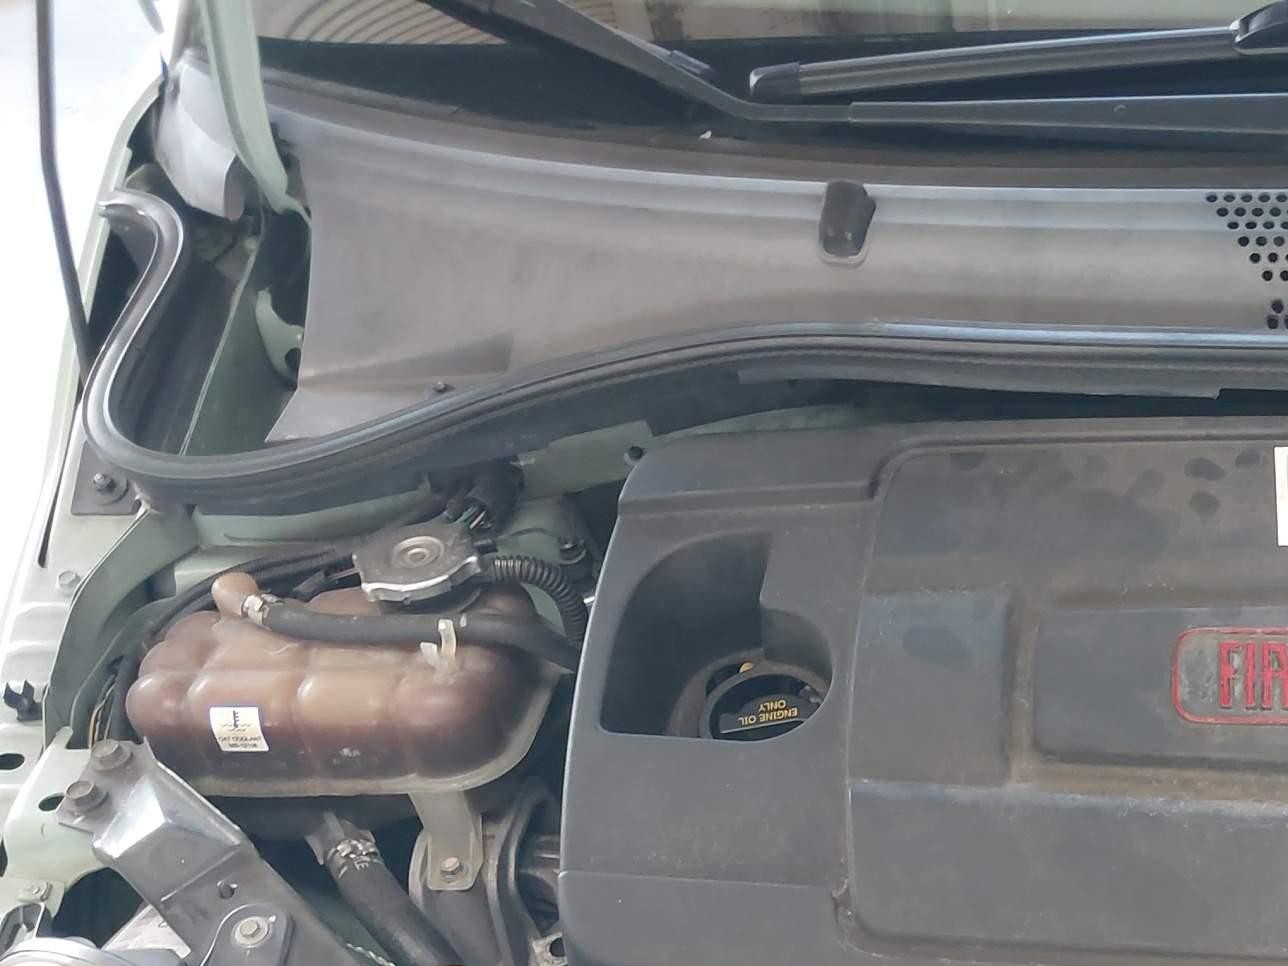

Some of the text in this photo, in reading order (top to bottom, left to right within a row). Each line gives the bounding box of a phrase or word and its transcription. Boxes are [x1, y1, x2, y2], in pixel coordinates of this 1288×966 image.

[758, 699, 787, 713] ONLY
[738, 707, 799, 726] ENGINE OIL
